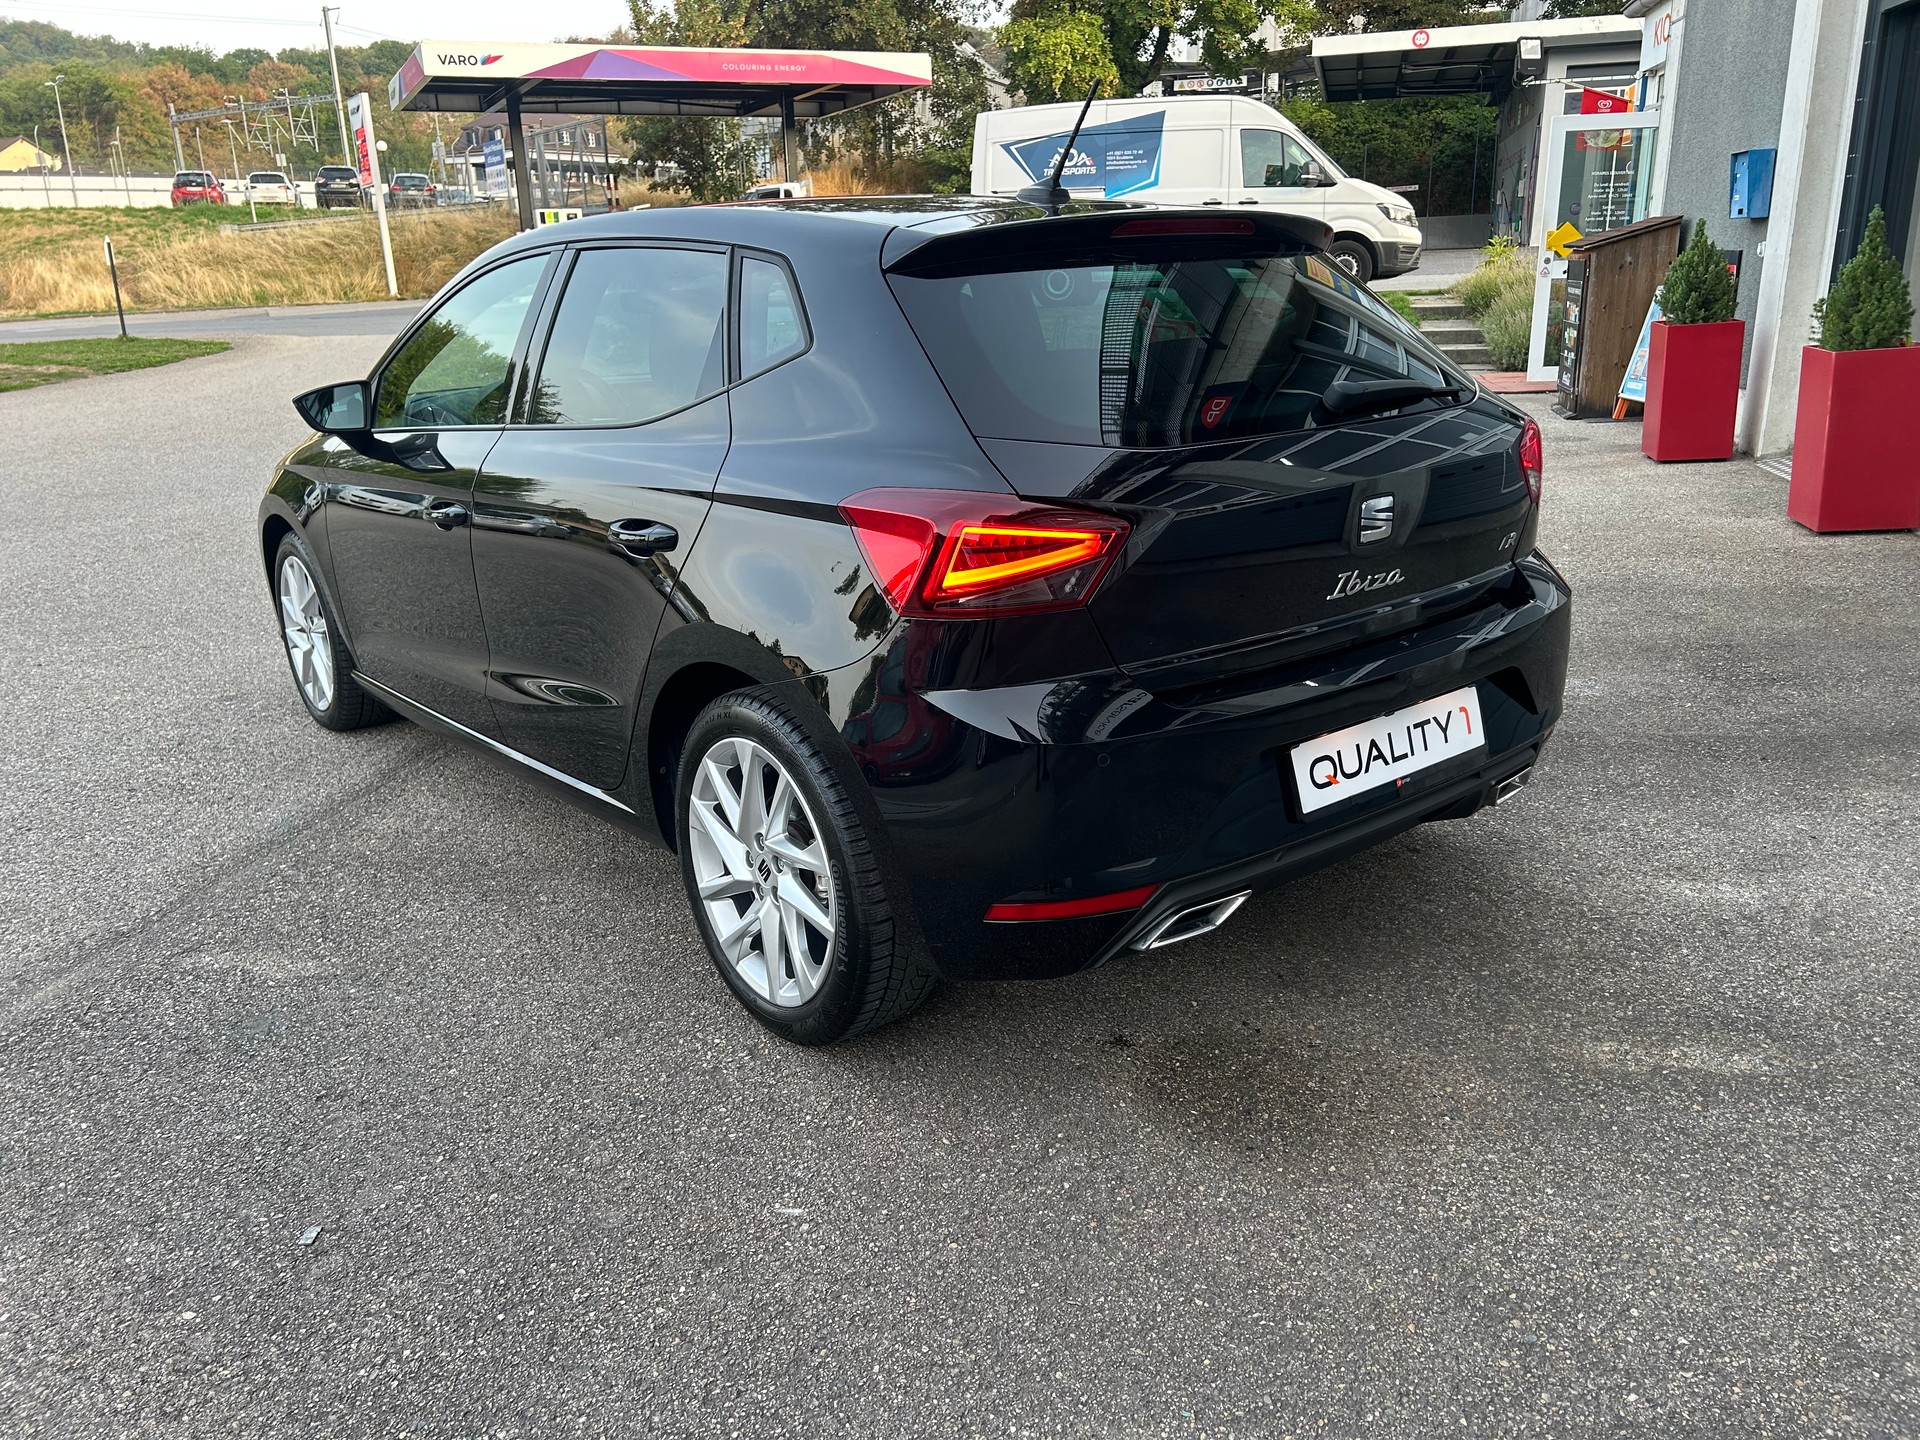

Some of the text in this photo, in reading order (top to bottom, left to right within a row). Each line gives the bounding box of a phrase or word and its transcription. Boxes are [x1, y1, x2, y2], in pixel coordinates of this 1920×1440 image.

[437, 54, 478, 66] VARO
[722, 63, 807, 72] COLOURING ENERGY
[1043, 166, 1097, 177] TRNSPORTS
[1326, 568, 1405, 601] Ibiza
[1309, 705, 1472, 790] QUALITY 1
[830, 858, 849, 964] Continental
